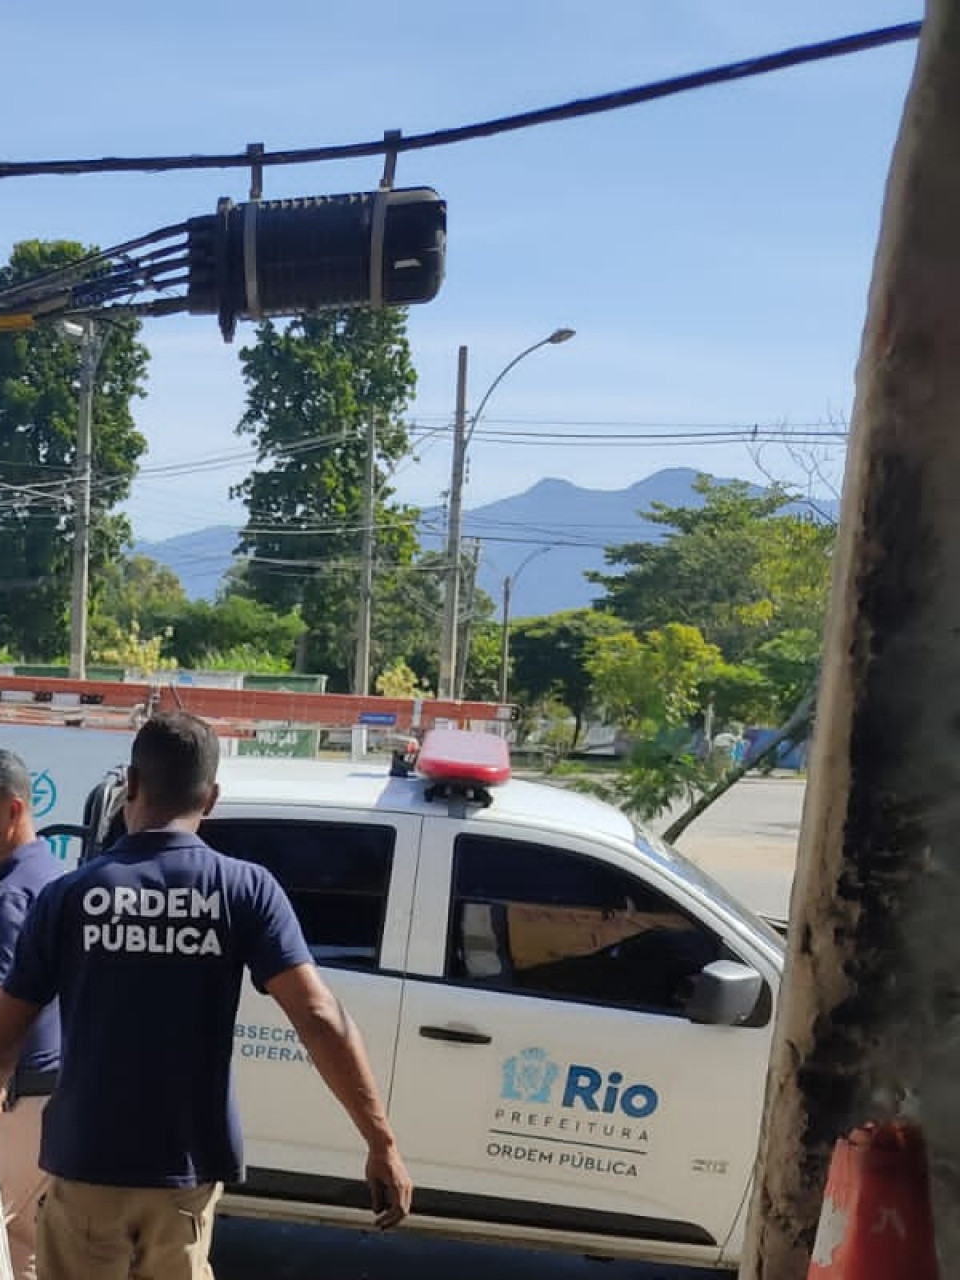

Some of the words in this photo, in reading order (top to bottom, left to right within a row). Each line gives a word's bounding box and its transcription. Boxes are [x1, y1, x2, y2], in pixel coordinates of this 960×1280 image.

[82, 886, 221, 920] ORDEM
[82, 915, 223, 956] PÚBLICA
[233, 1024, 296, 1043] BSECR
[561, 1063, 659, 1119] Rio
[494, 1108, 651, 1142] PREFEITURA
[486, 1143, 553, 1165] ORDEM
[558, 1151, 639, 1177] PÚBLICA
